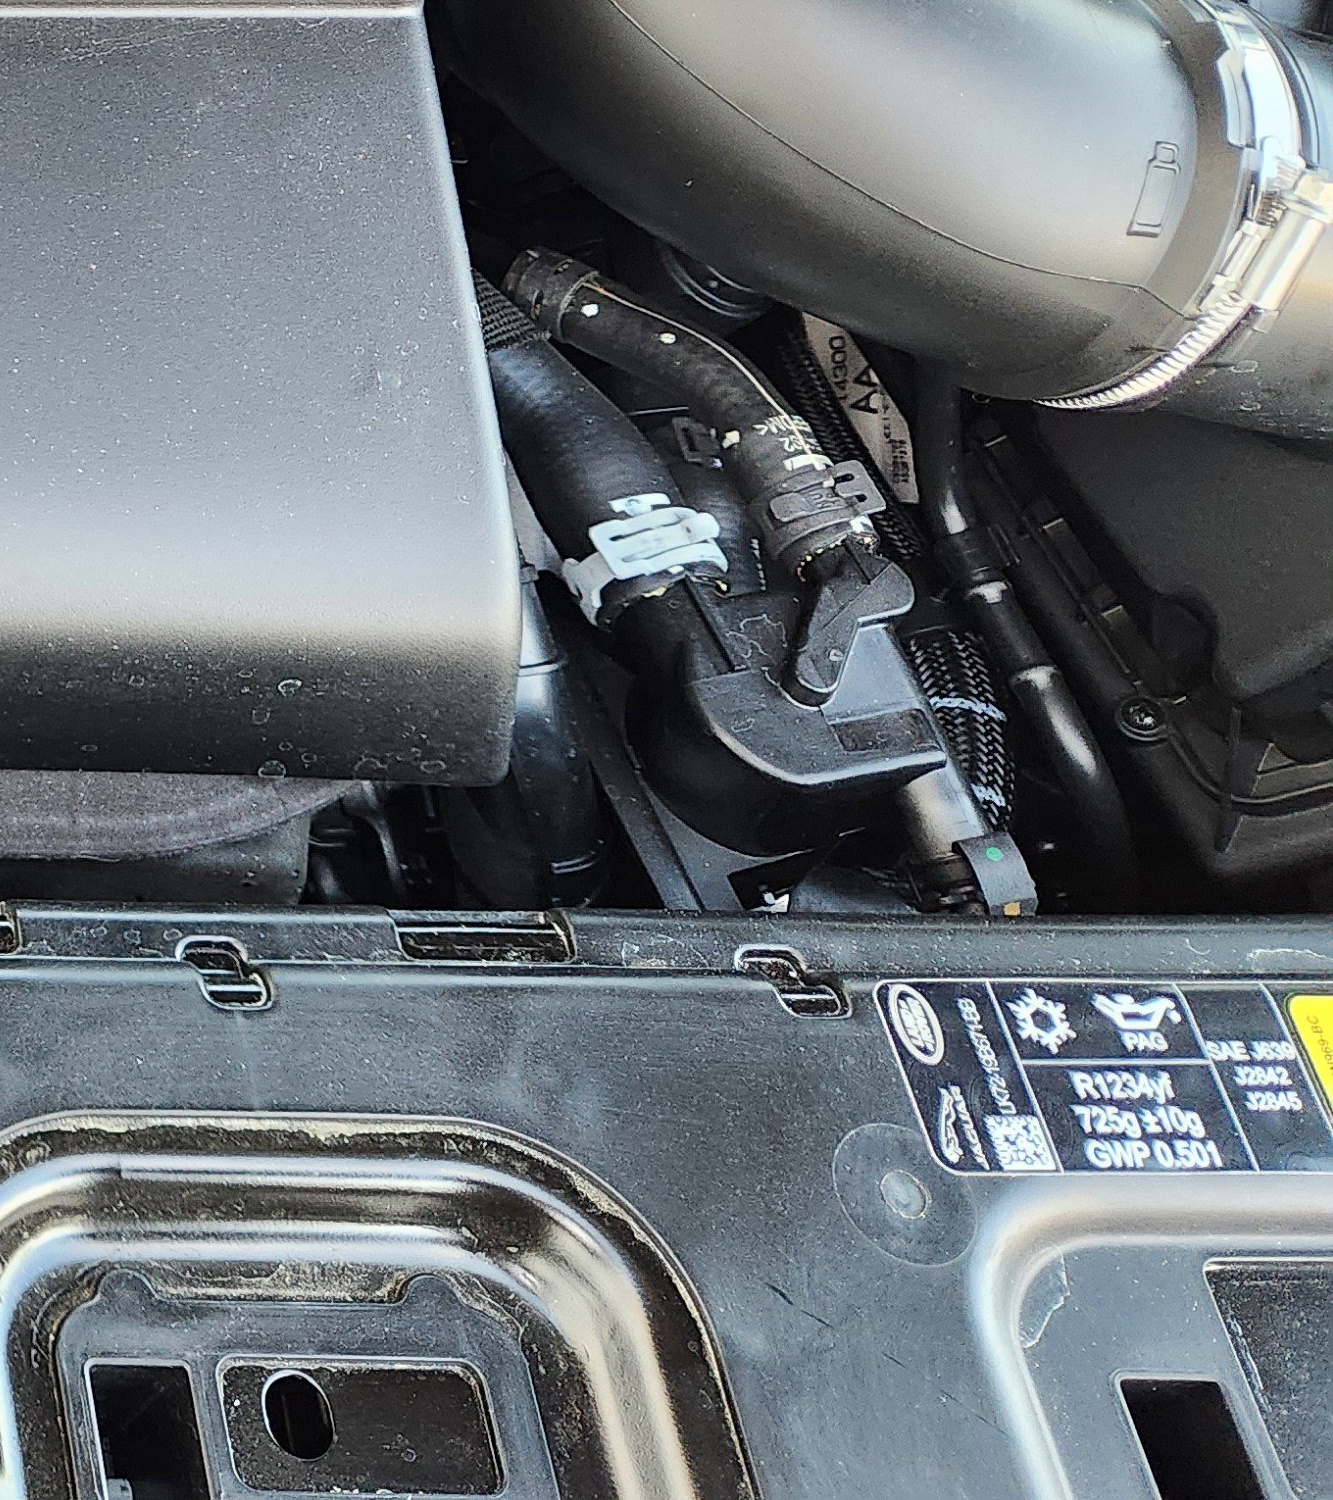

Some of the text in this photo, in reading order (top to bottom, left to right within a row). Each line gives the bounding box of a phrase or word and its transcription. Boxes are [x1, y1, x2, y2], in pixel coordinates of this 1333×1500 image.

[1119, 1030, 1169, 1052] PAG
[1206, 1040, 1251, 1061] SAE
[1233, 1065, 1293, 1086] J2842
[1069, 1070, 1175, 1104] R1234yf
[1244, 1091, 1303, 1112] J2845
[949, 1084, 991, 1171] JAGUAR
[1083, 1137, 1224, 1169] GWP 0.501
